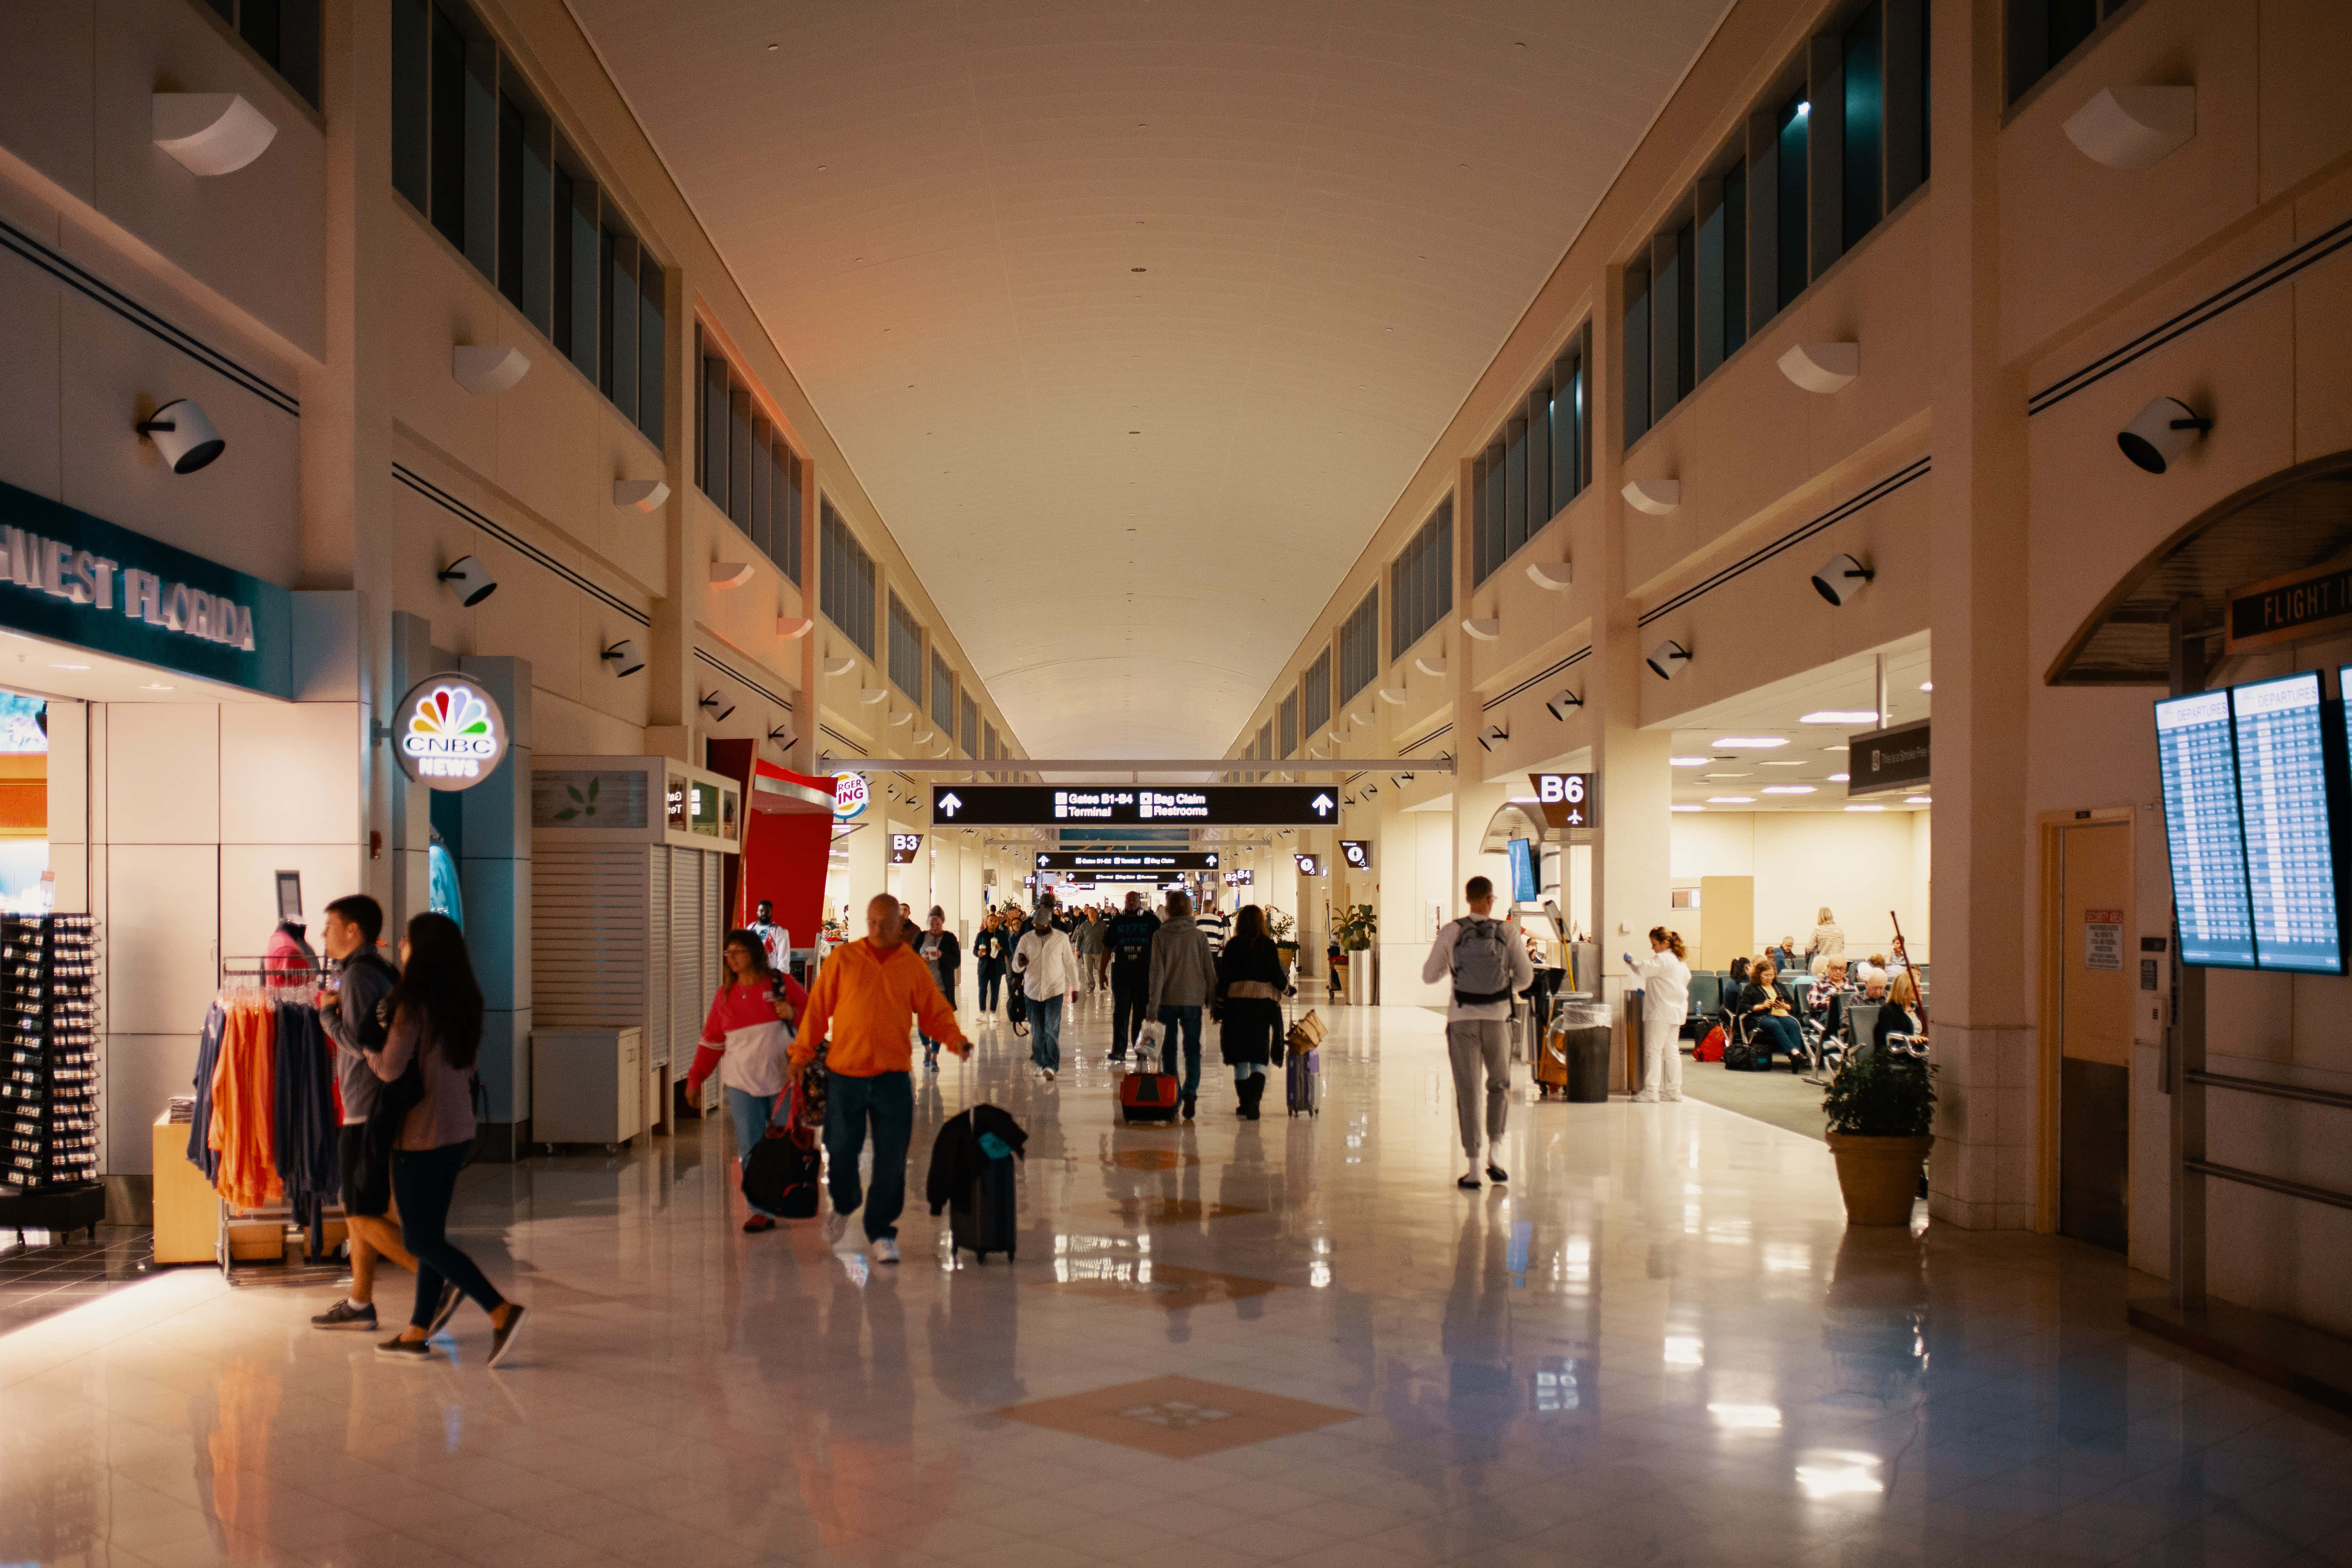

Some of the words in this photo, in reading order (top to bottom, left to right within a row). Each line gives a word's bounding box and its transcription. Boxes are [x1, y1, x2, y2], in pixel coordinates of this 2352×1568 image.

[124, 568, 255, 651] FLORIDA
[2263, 582, 2331, 626] FLIGHT
[2258, 686, 2318, 708] DEPARTURES
[2177, 702, 2228, 722] DEPARTURES
[406, 736, 491, 754] CNBC
[419, 758, 479, 778] NEWS
[1540, 775, 1584, 803] B6
[1069, 793, 1099, 804] Gates
[1101, 793, 1133, 804] B1-B4
[1153, 793, 1175, 806] Bag
[1176, 793, 1206, 804] Claim
[1068, 806, 1112, 817] Terminal
[1153, 805, 1208, 816] Restrooms
[893, 834, 917, 851] B3
[1025, 876, 1036, 884] B1
[1225, 873, 1237, 882] B2
[1237, 870, 1251, 879] B4
[2086, 911, 2108, 922] SECURITY
[2110, 911, 2123, 923] AREA
[1118, 923, 1148, 933] SIZE
